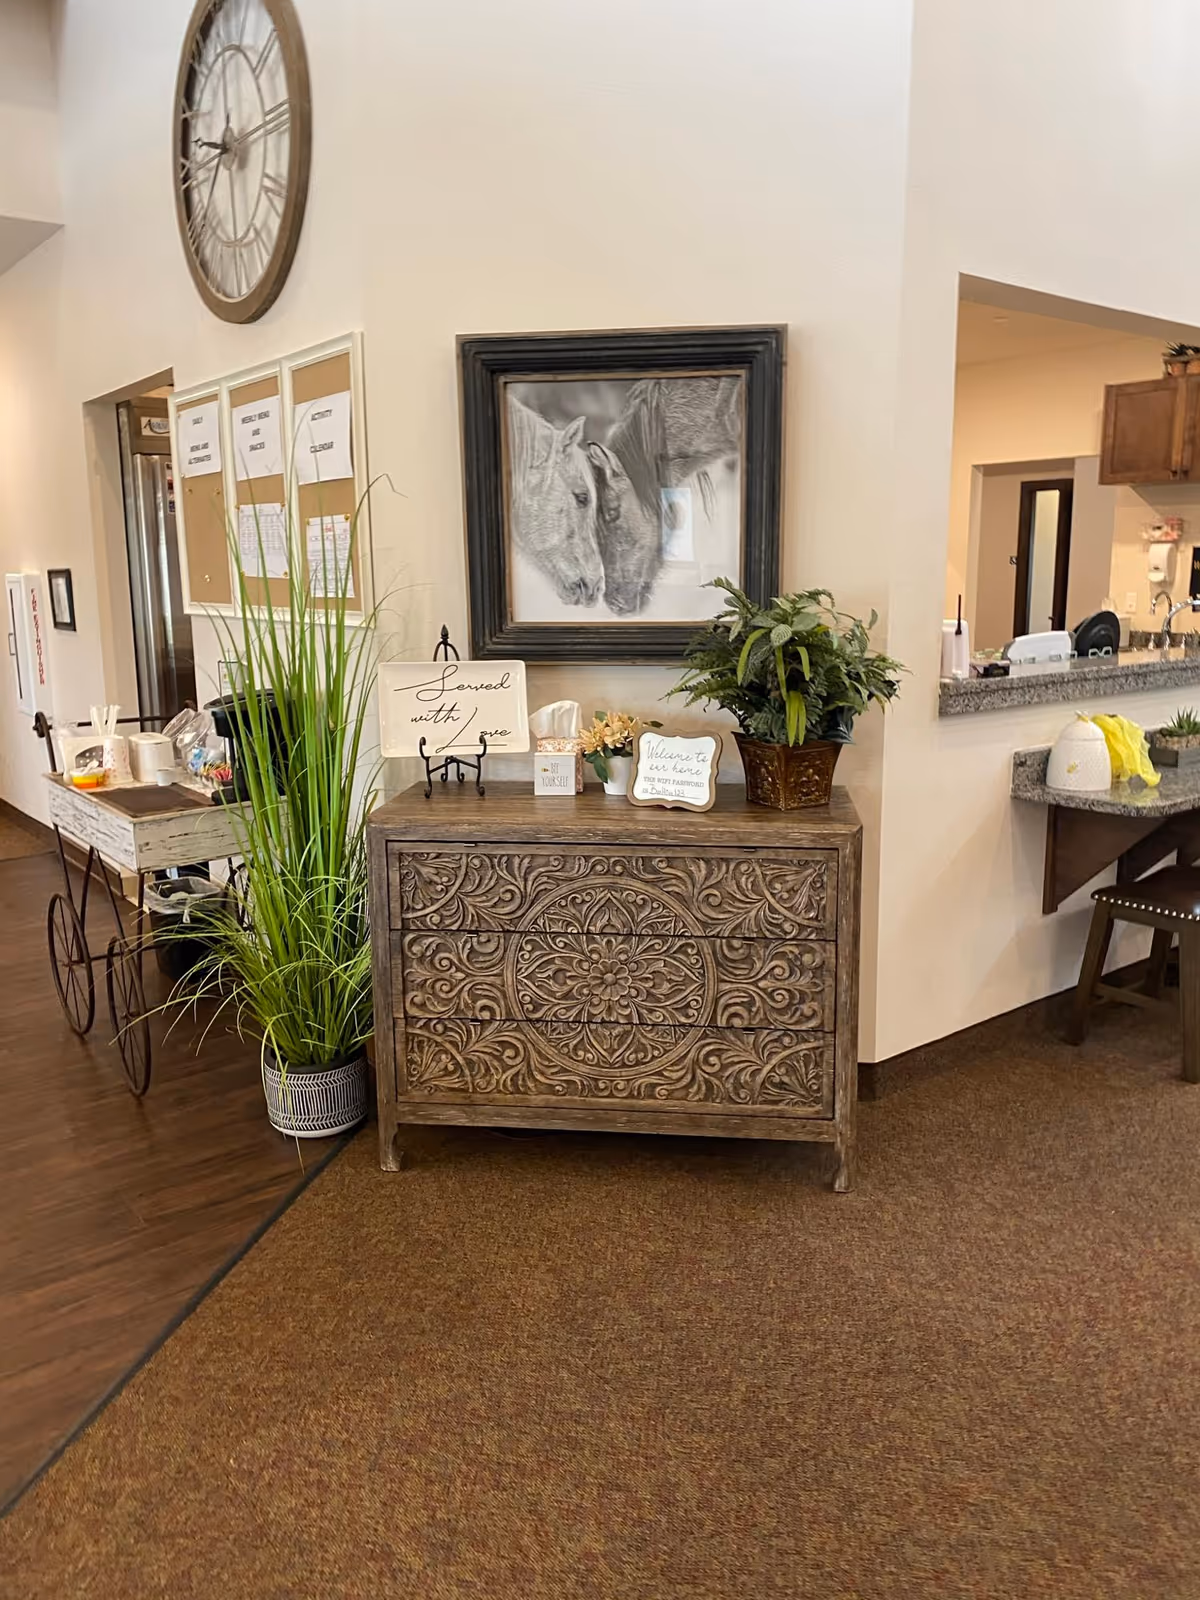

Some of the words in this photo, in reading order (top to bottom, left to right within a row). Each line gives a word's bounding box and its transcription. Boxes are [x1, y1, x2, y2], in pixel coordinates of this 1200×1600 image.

[310, 409, 333, 421] ACTIVITY
[310, 441, 334, 453] CALENDAR
[394, 665, 511, 701] Served
[410, 702, 461, 723] with
[435, 707, 511, 753] Love
[647, 739, 693, 762] Welcome
[695, 752, 709, 763] to
[649, 763, 668, 772] our
[672, 761, 703, 776] home
[541, 775, 569, 788] YOURSELF
[672, 779, 705, 788] PASSWORD
